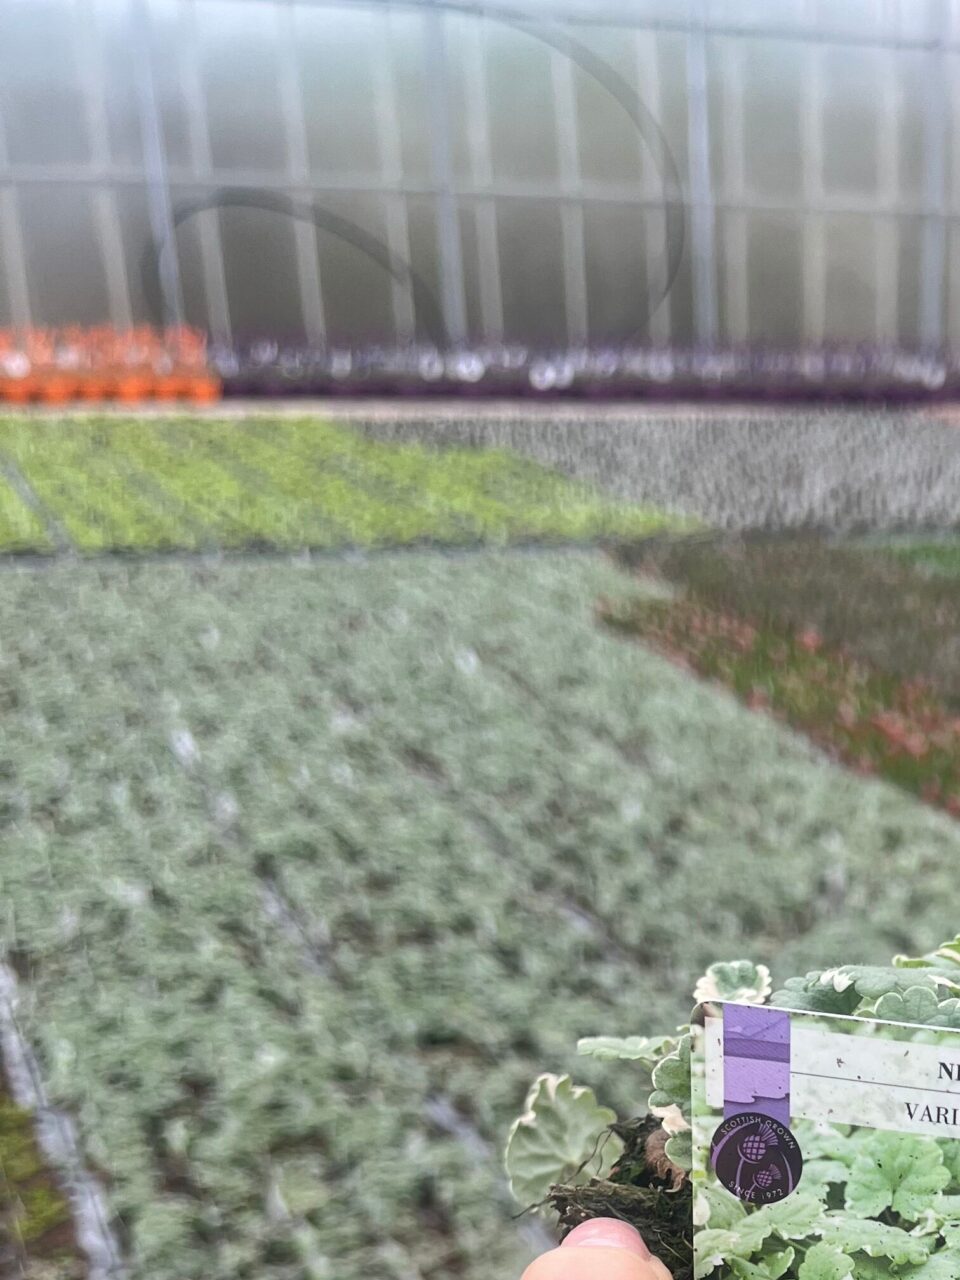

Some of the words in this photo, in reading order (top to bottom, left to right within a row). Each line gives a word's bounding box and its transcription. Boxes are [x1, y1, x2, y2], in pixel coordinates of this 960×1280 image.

[720, 1115, 762, 1135] SCOTTISH
[765, 1119, 796, 1150] GROWN
[728, 1180, 756, 1199] SINCE
[761, 1188, 785, 1200] 1972
